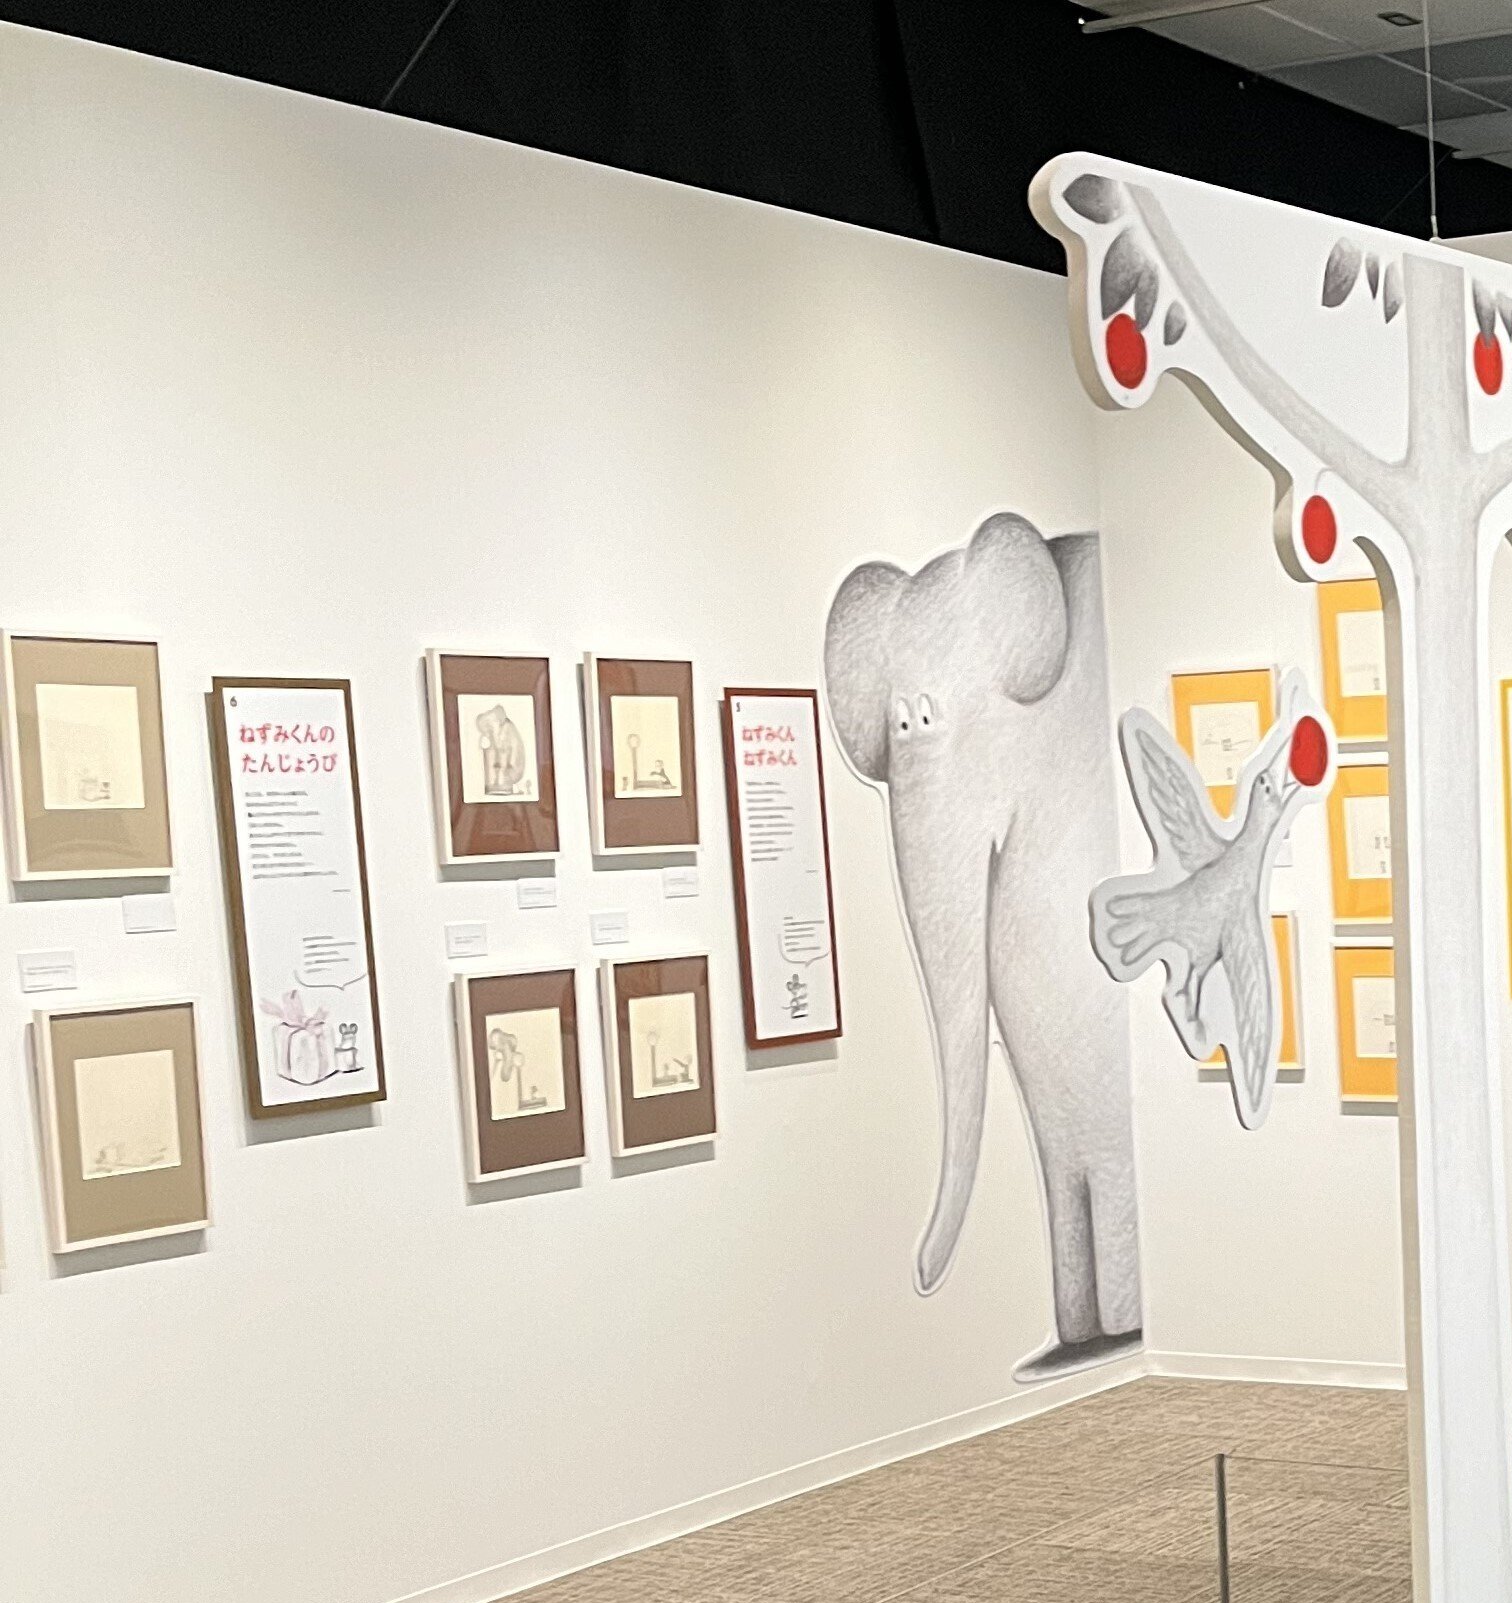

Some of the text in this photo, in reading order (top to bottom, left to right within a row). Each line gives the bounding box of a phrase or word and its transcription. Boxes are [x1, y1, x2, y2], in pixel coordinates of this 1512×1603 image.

[240, 723, 335, 744] ねずみくんの
[242, 753, 338, 774] たんじょうび
